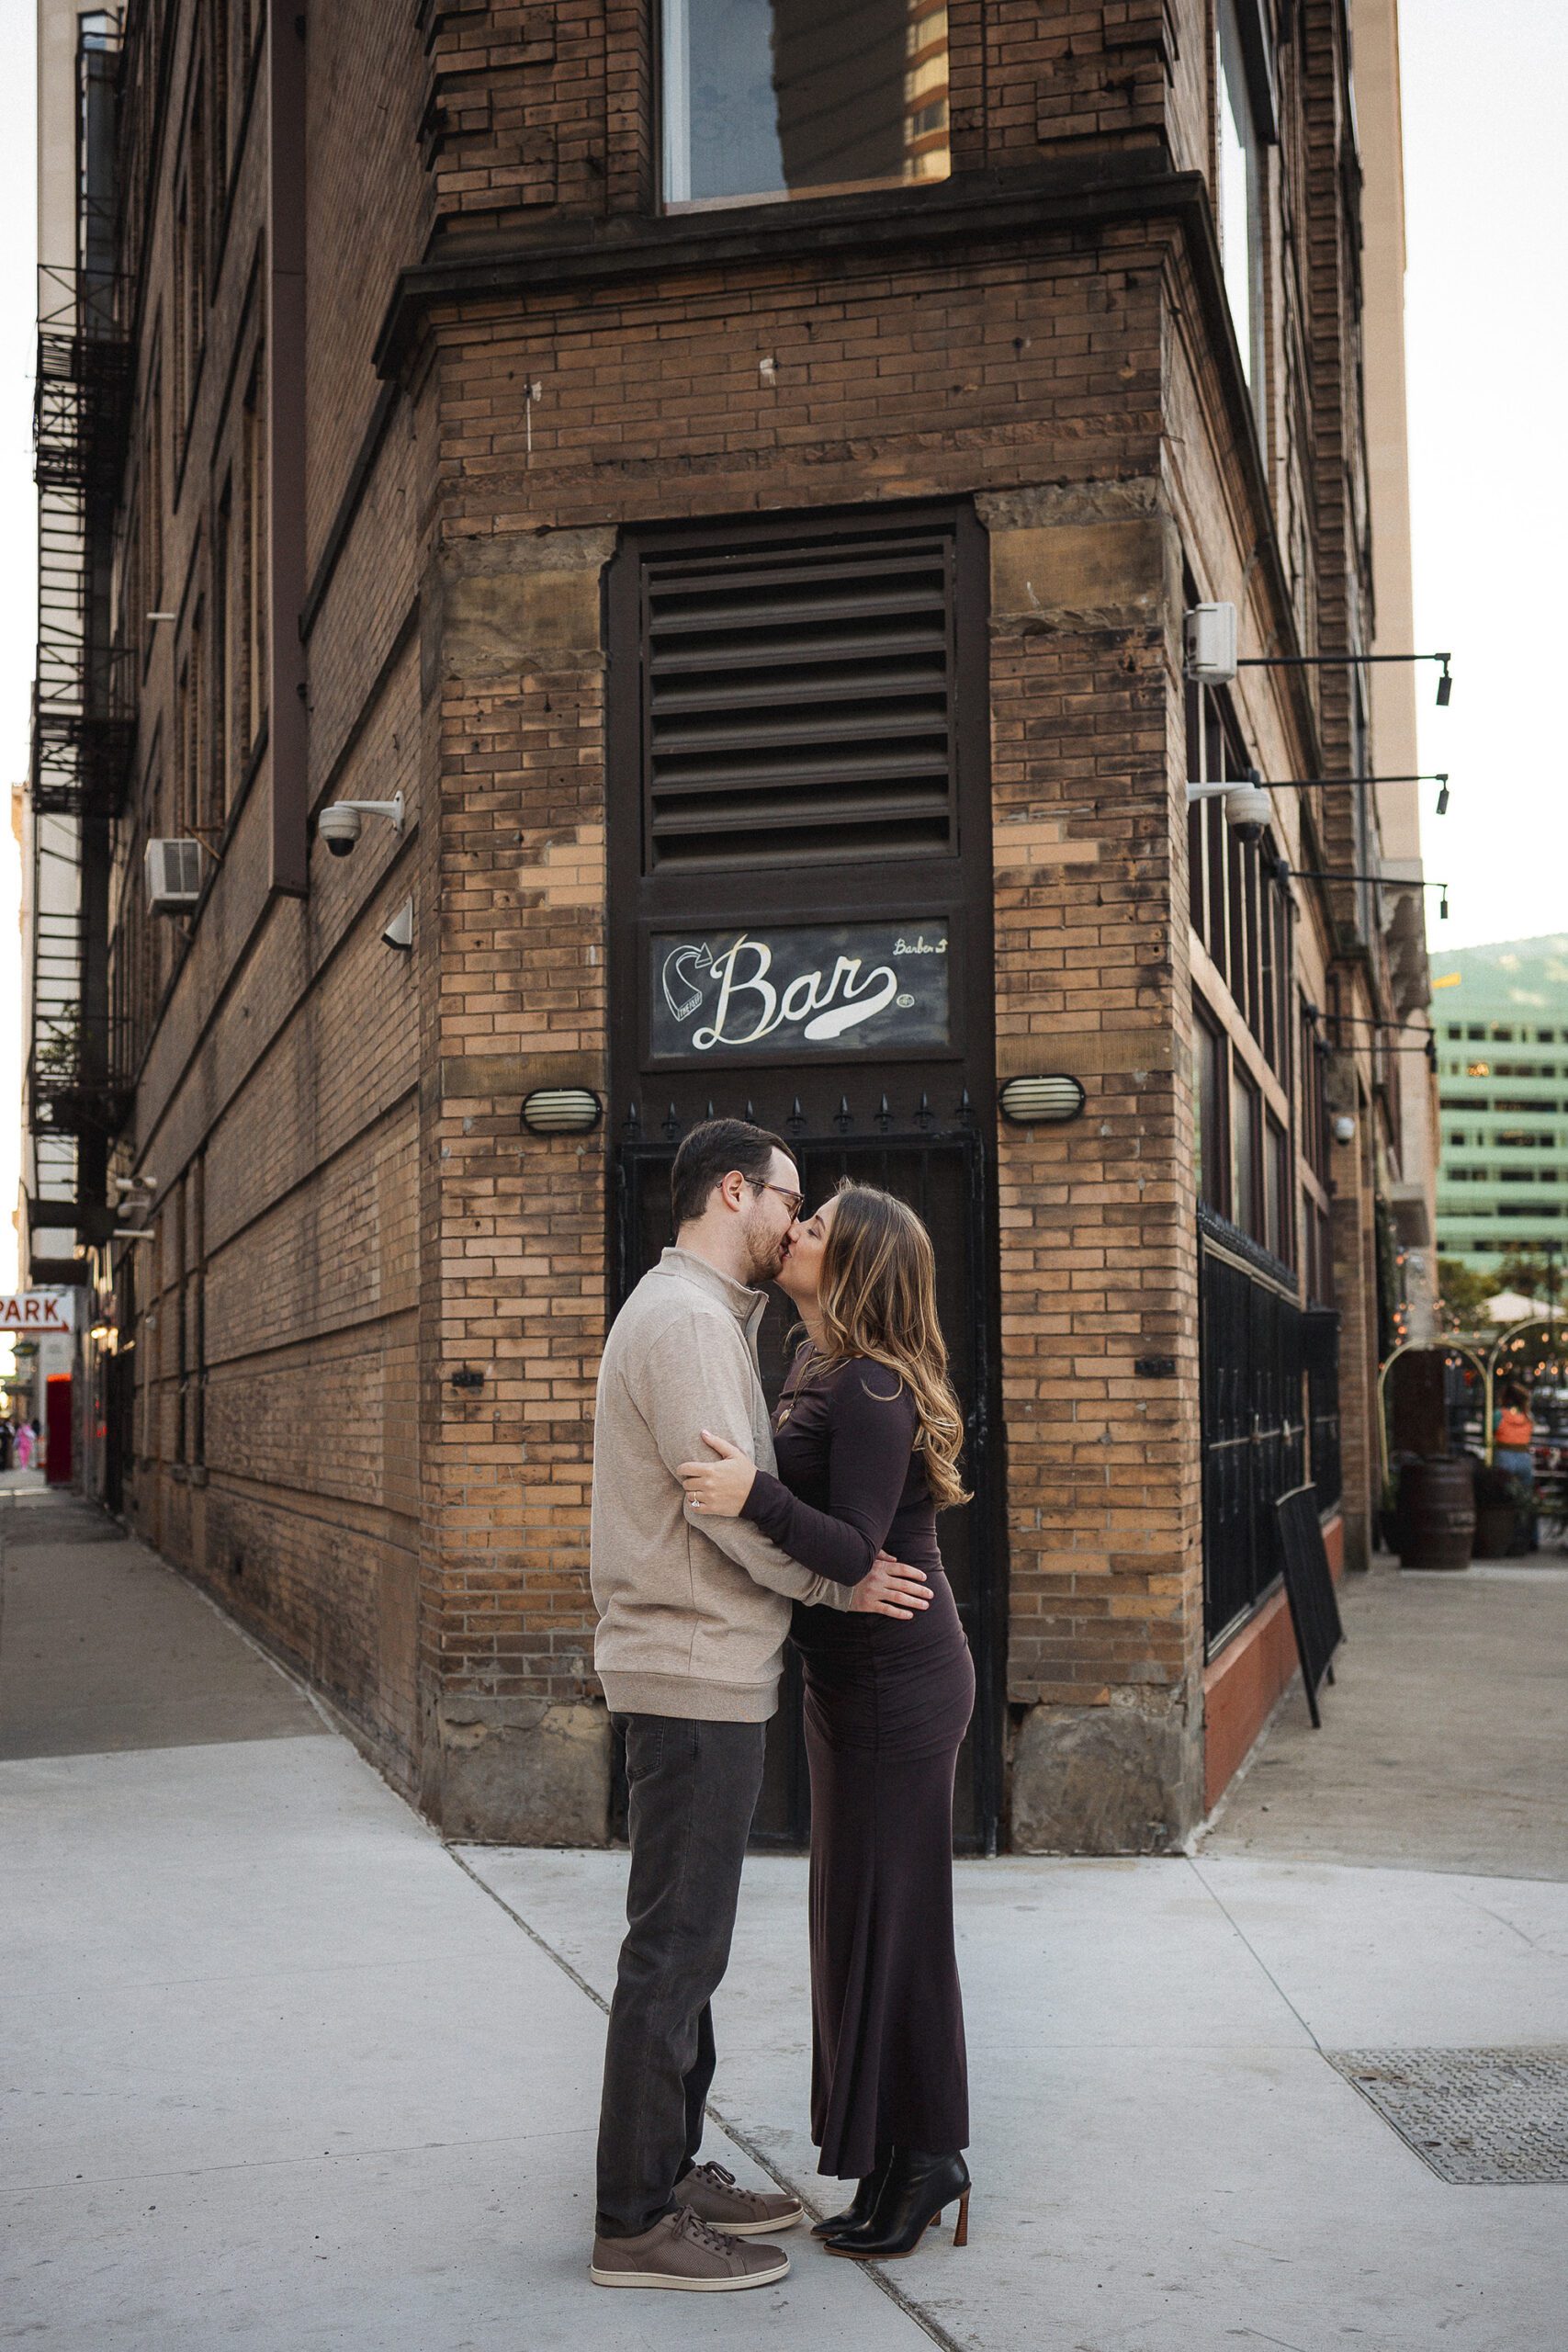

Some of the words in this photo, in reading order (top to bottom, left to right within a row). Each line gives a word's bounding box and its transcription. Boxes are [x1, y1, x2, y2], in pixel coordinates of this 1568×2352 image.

[892, 935, 934, 956] Barber
[693, 933, 897, 1049] Bar
[0, 1299, 59, 1321] ARK
